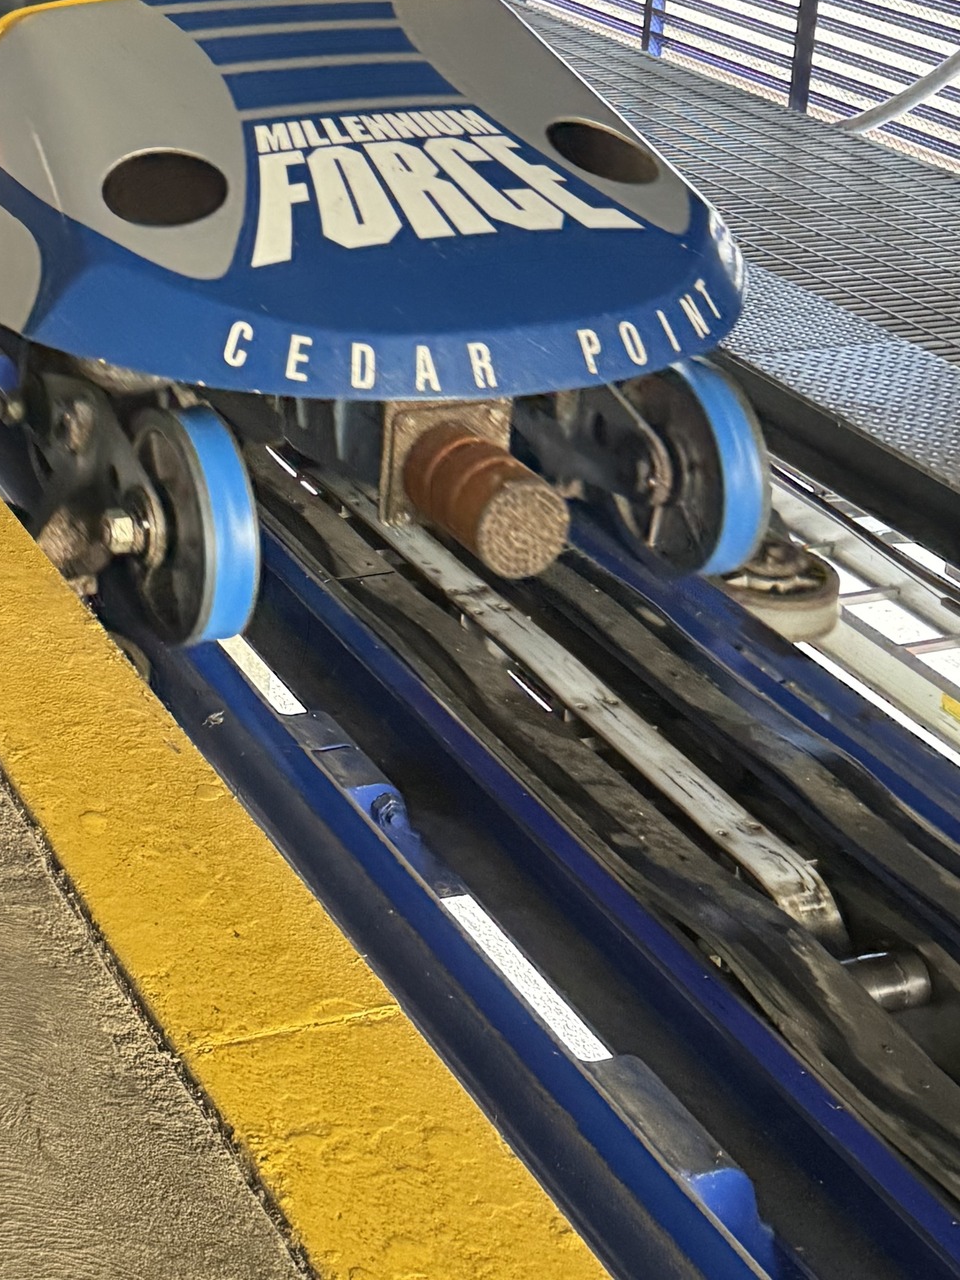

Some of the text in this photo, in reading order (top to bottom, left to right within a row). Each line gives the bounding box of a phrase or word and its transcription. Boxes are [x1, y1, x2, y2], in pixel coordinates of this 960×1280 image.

[254, 109, 503, 155] MILLENNIUM
[251, 134, 646, 268] FORCE
[223, 277, 723, 392] CEDAR POINT
